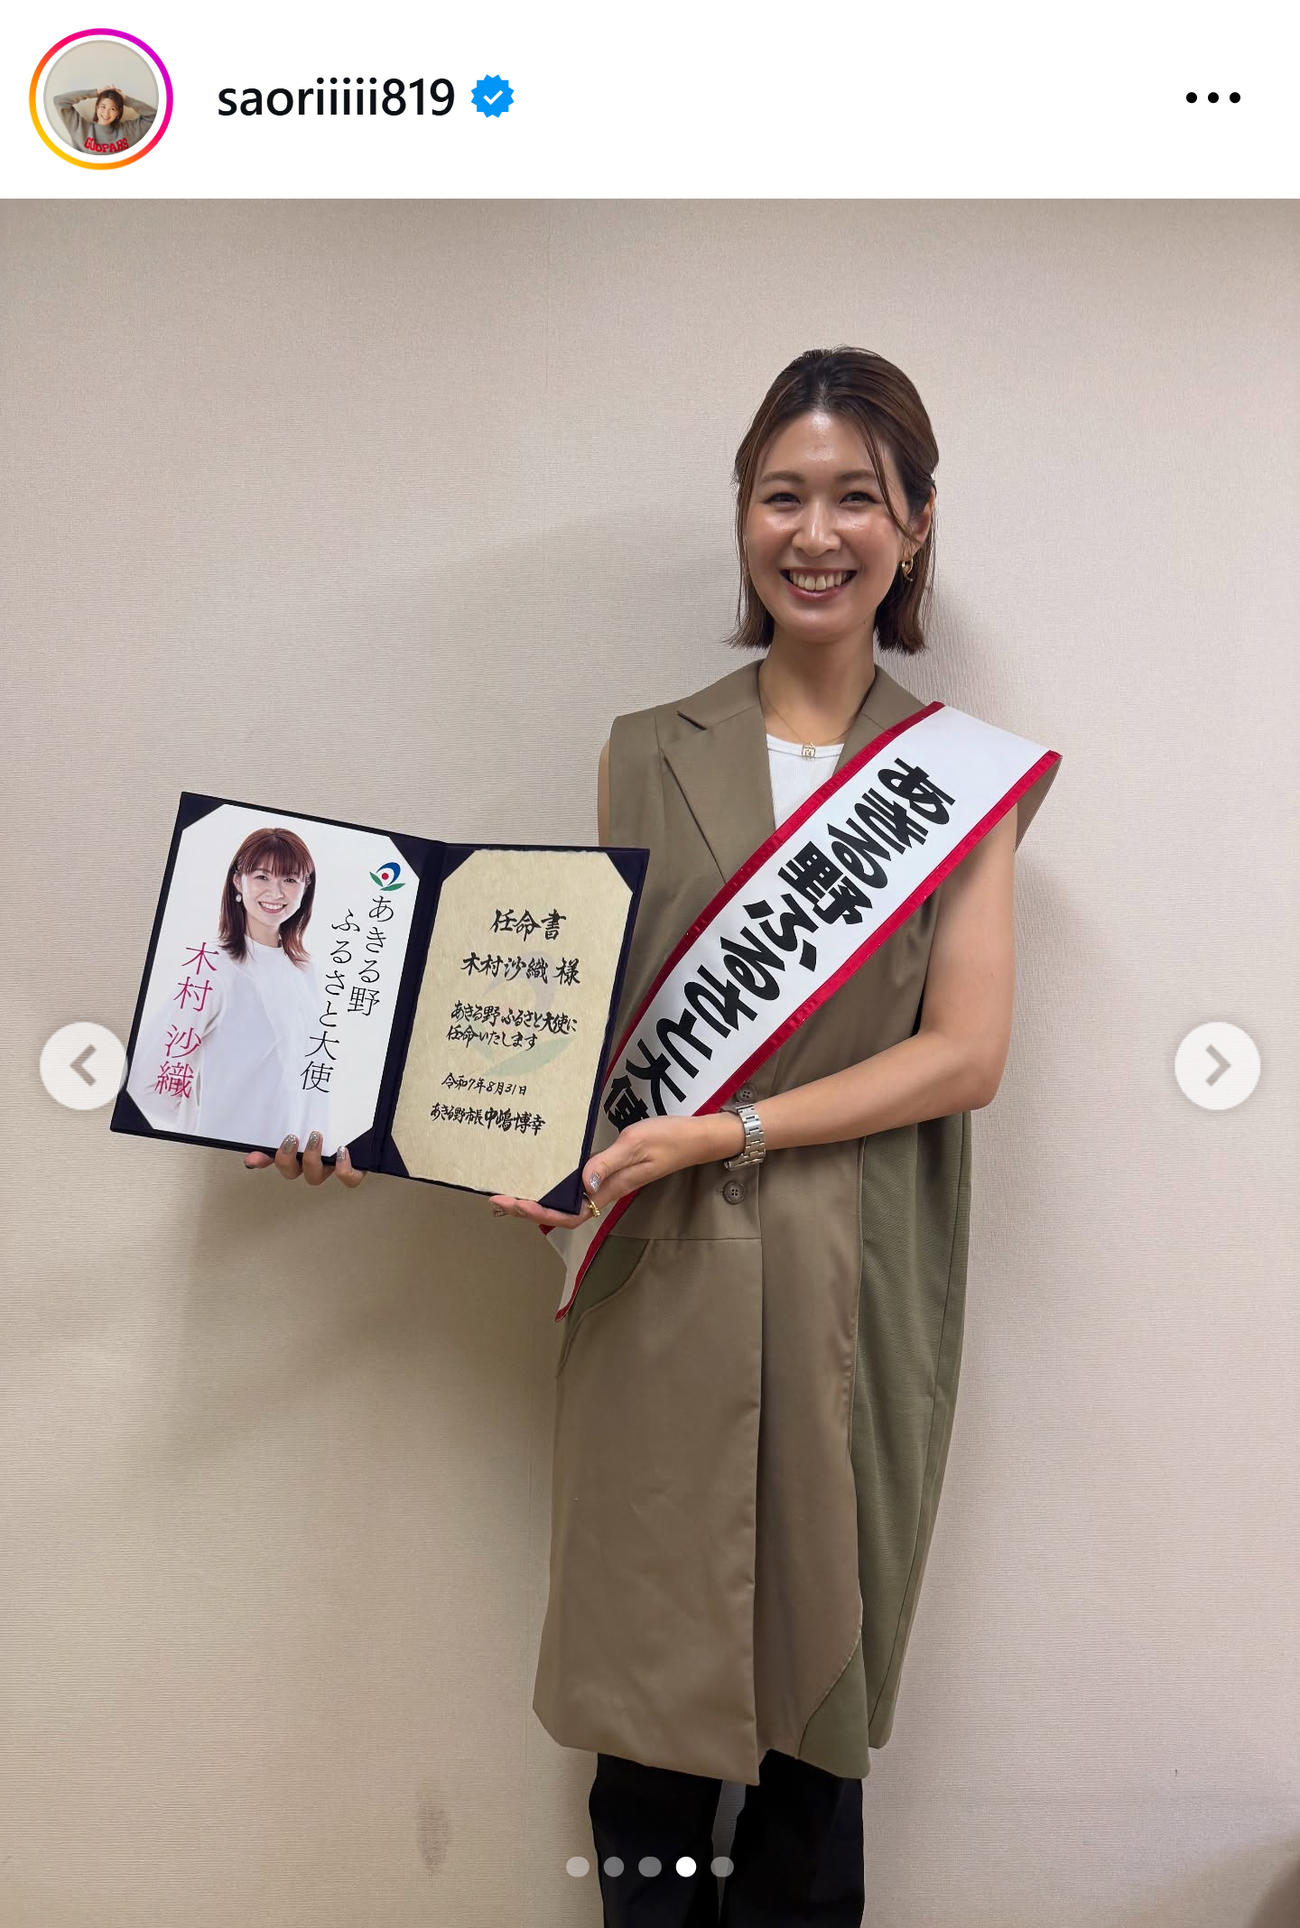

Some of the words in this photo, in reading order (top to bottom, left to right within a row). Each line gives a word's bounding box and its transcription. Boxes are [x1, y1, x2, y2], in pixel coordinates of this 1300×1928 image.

[490, 908, 567, 942] 任命書
[347, 894, 395, 1017] あきる野
[300, 908, 361, 1094] ふるさと大使
[446, 1024, 538, 1051] 任命いたします
[441, 1072, 527, 1096] 令和7年8月31日
